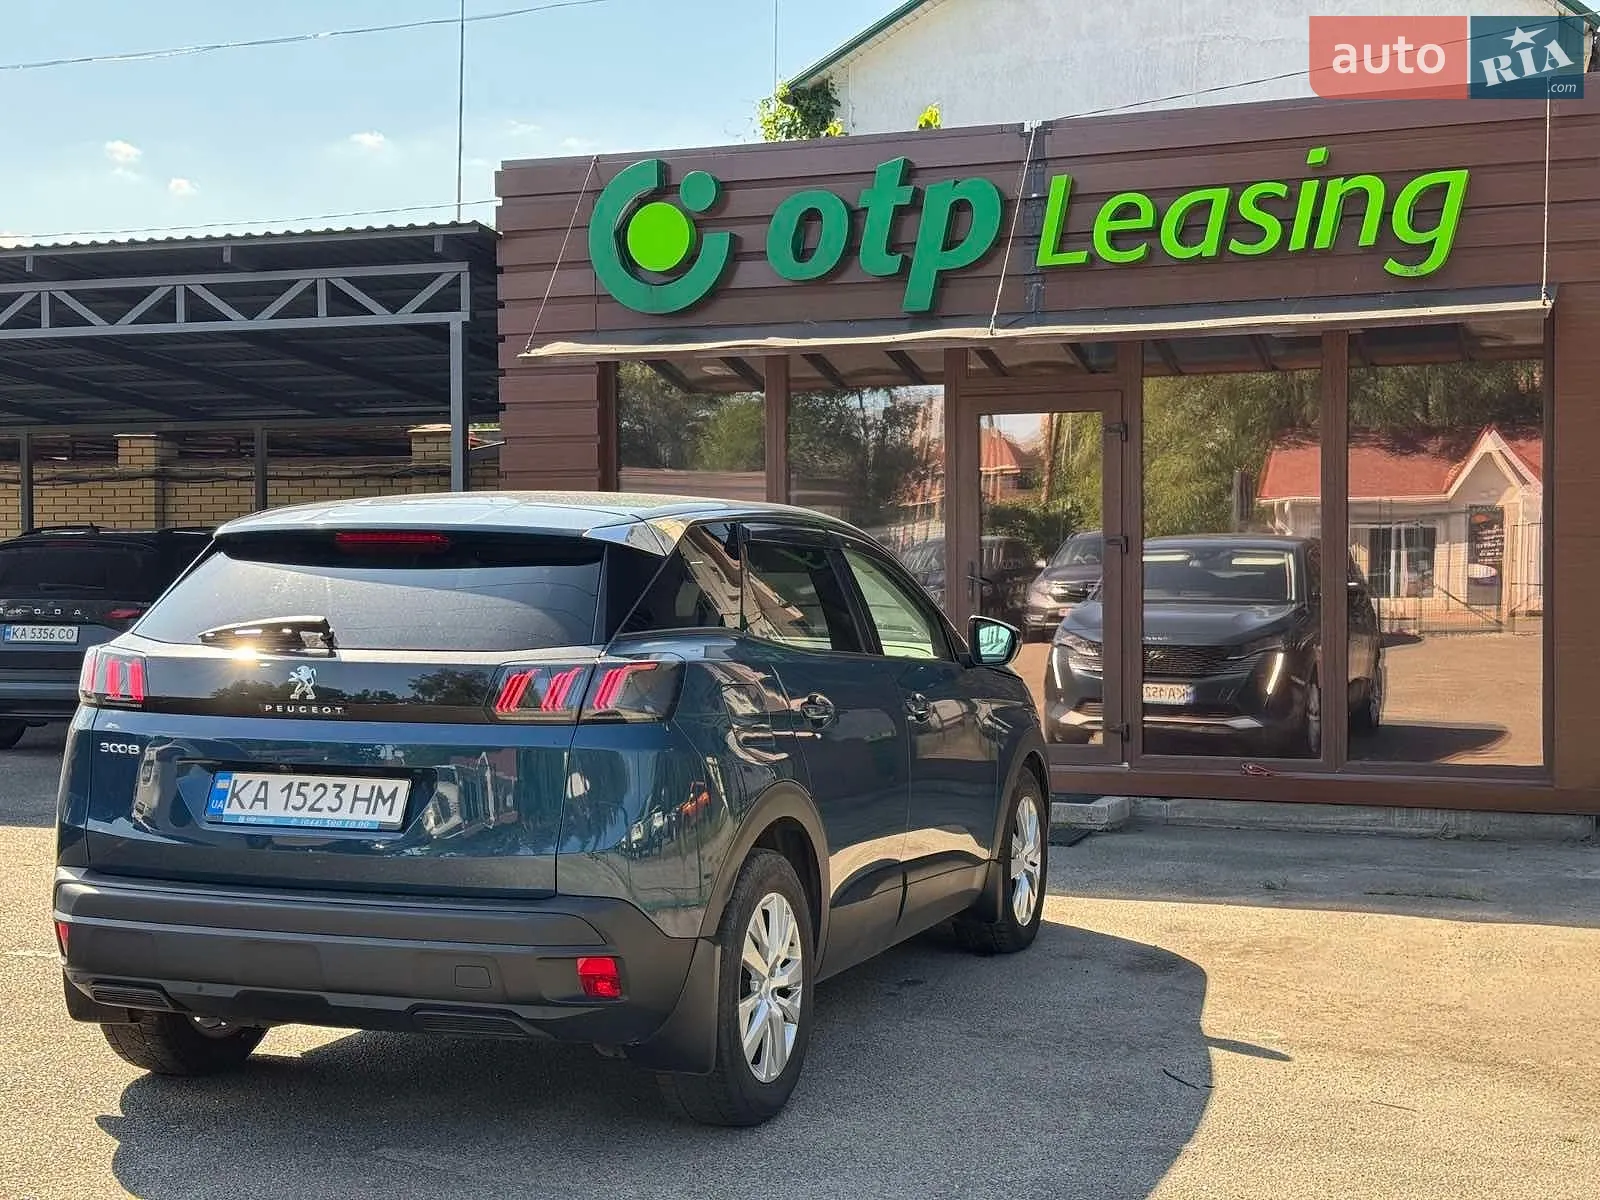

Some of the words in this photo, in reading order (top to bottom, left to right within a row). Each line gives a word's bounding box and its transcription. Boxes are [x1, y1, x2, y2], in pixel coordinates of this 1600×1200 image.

[766, 156, 1005, 314] otp
[1036, 147, 1470, 278] Leasing
[12, 627, 27, 640] KA
[30, 627, 55, 640] 5356
[58, 628, 74, 640] CO
[264, 704, 343, 714] PEUGEOT
[100, 742, 140, 755] 3008
[211, 799, 224, 809] UA
[227, 779, 270, 811] KA
[280, 781, 347, 814] 1523
[350, 785, 399, 816] HM
